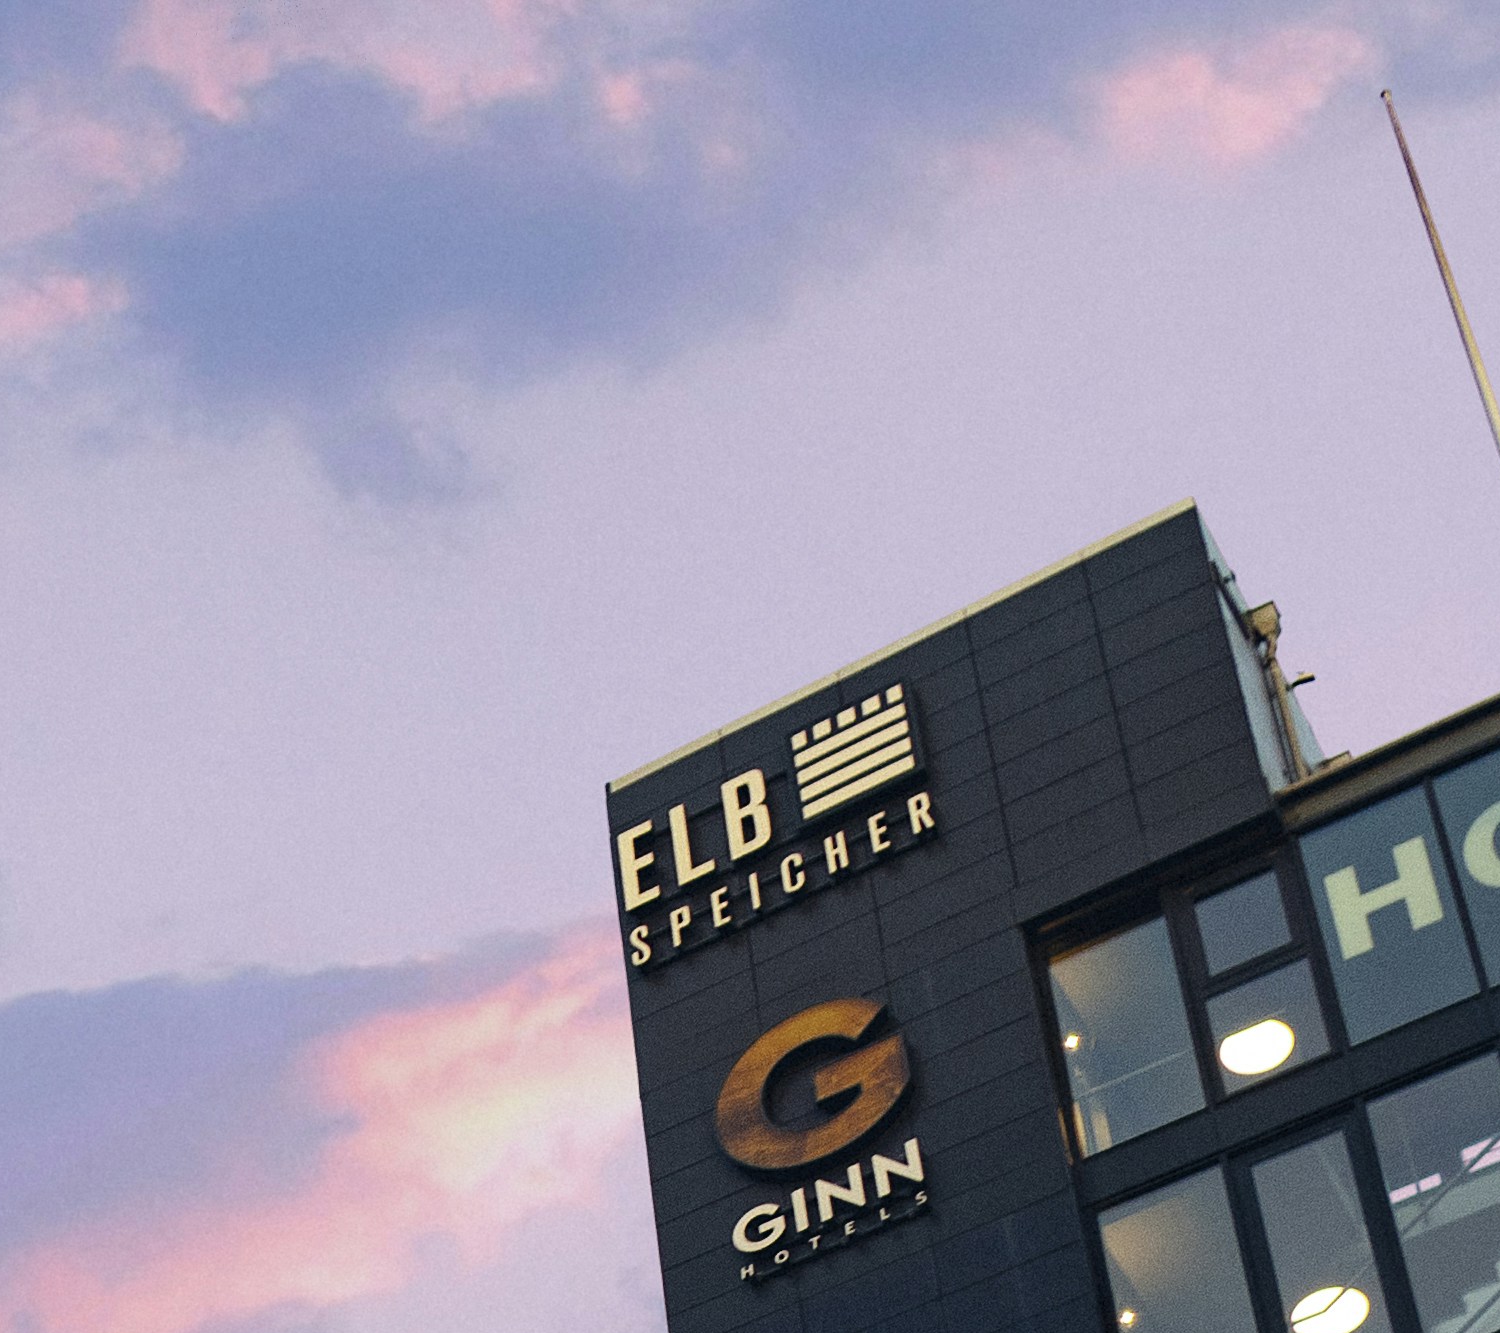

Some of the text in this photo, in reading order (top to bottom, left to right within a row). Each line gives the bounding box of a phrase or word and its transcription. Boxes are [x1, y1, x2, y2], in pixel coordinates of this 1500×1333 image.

[617, 768, 772, 911] ELB
[630, 791, 936, 967] SPEICHER
[714, 998, 911, 1169] G
[731, 1137, 925, 1253] GINN
[740, 1190, 928, 1281] HOTELS
